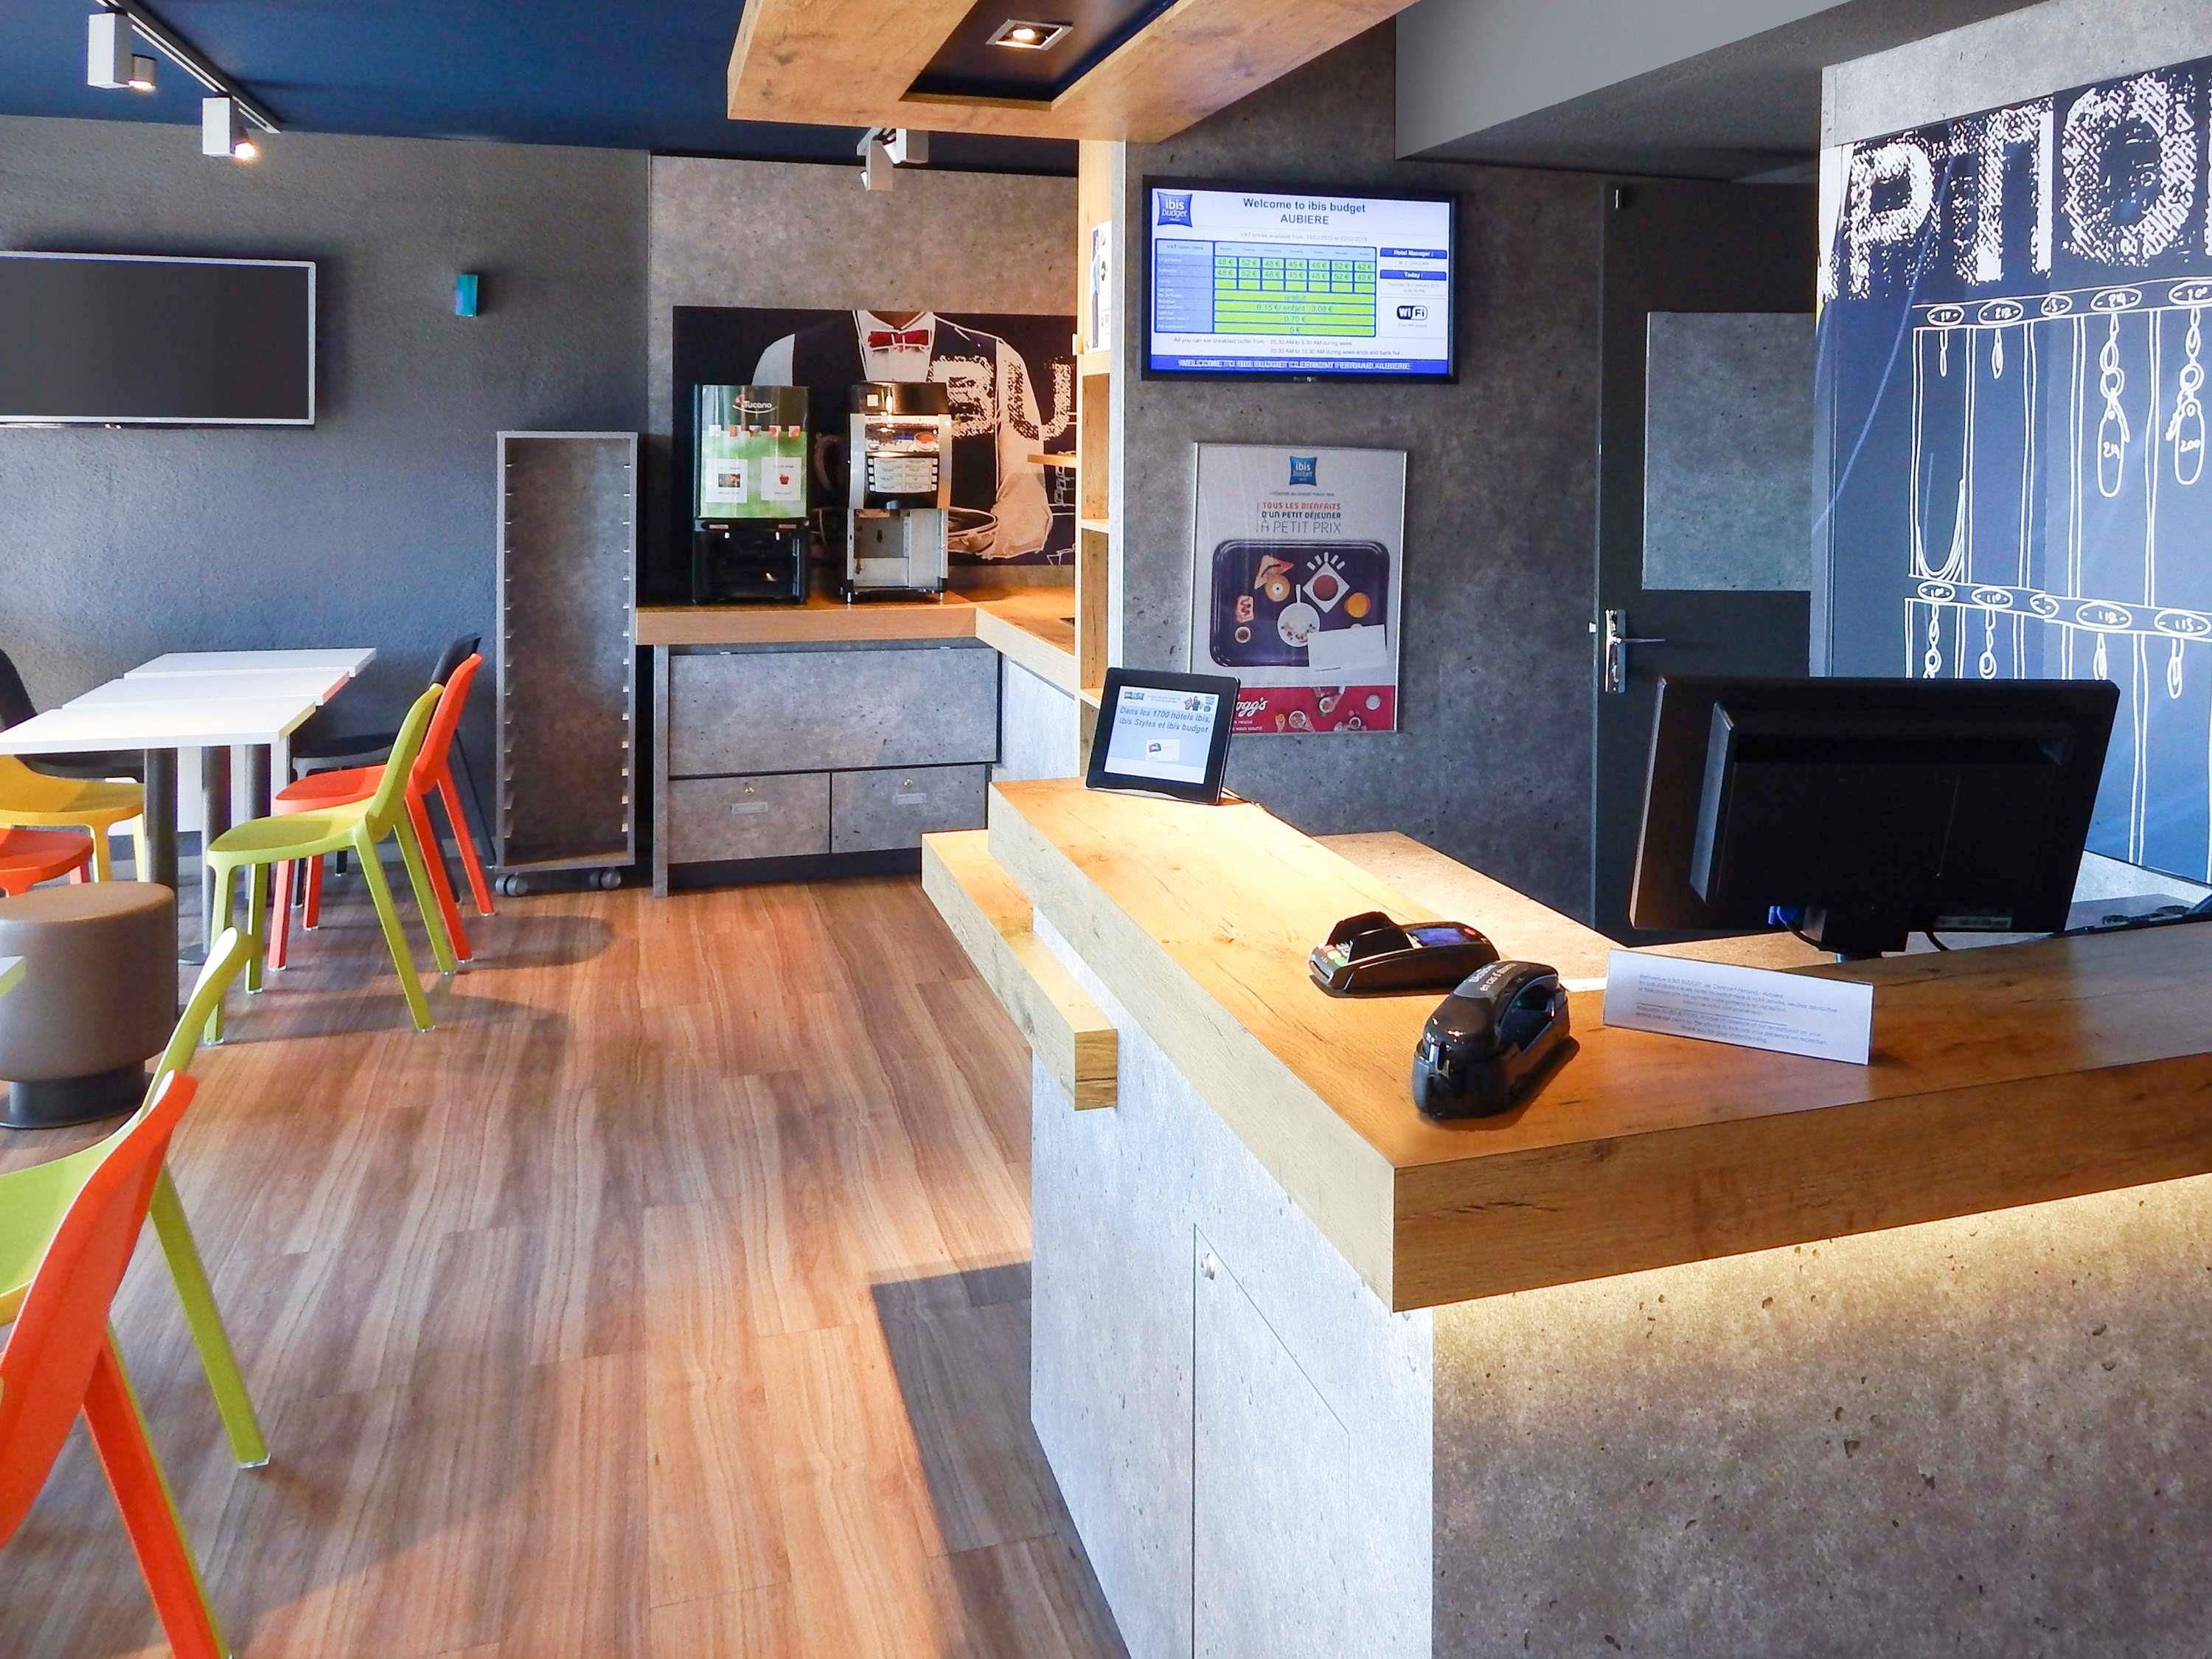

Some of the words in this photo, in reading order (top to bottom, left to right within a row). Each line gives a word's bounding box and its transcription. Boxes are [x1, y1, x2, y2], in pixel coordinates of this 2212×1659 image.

[1164, 198, 1186, 210] ibis
[1243, 198, 1292, 209] Welcome
[1295, 201, 1305, 210] to
[1308, 201, 1326, 211] ibis
[1330, 202, 1366, 215] budget
[1280, 214, 1329, 225] AUBIERE
[742, 400, 772, 408] Tucano
[1295, 461, 1311, 471] ibis
[1262, 501, 1284, 509] TOUS
[1285, 502, 1299, 510] LES
[1301, 502, 1341, 510] BIENFAITS
[1281, 511, 1303, 519] PETIT
[1273, 521, 1310, 534] PETIT
[1312, 521, 1341, 534] PRIX
[1119, 706, 1138, 715] Dans
[1139, 709, 1151, 717] les
[1134, 718, 1156, 728] Styles
[1166, 722, 1180, 730] ibis
[1182, 724, 1208, 734] budget
